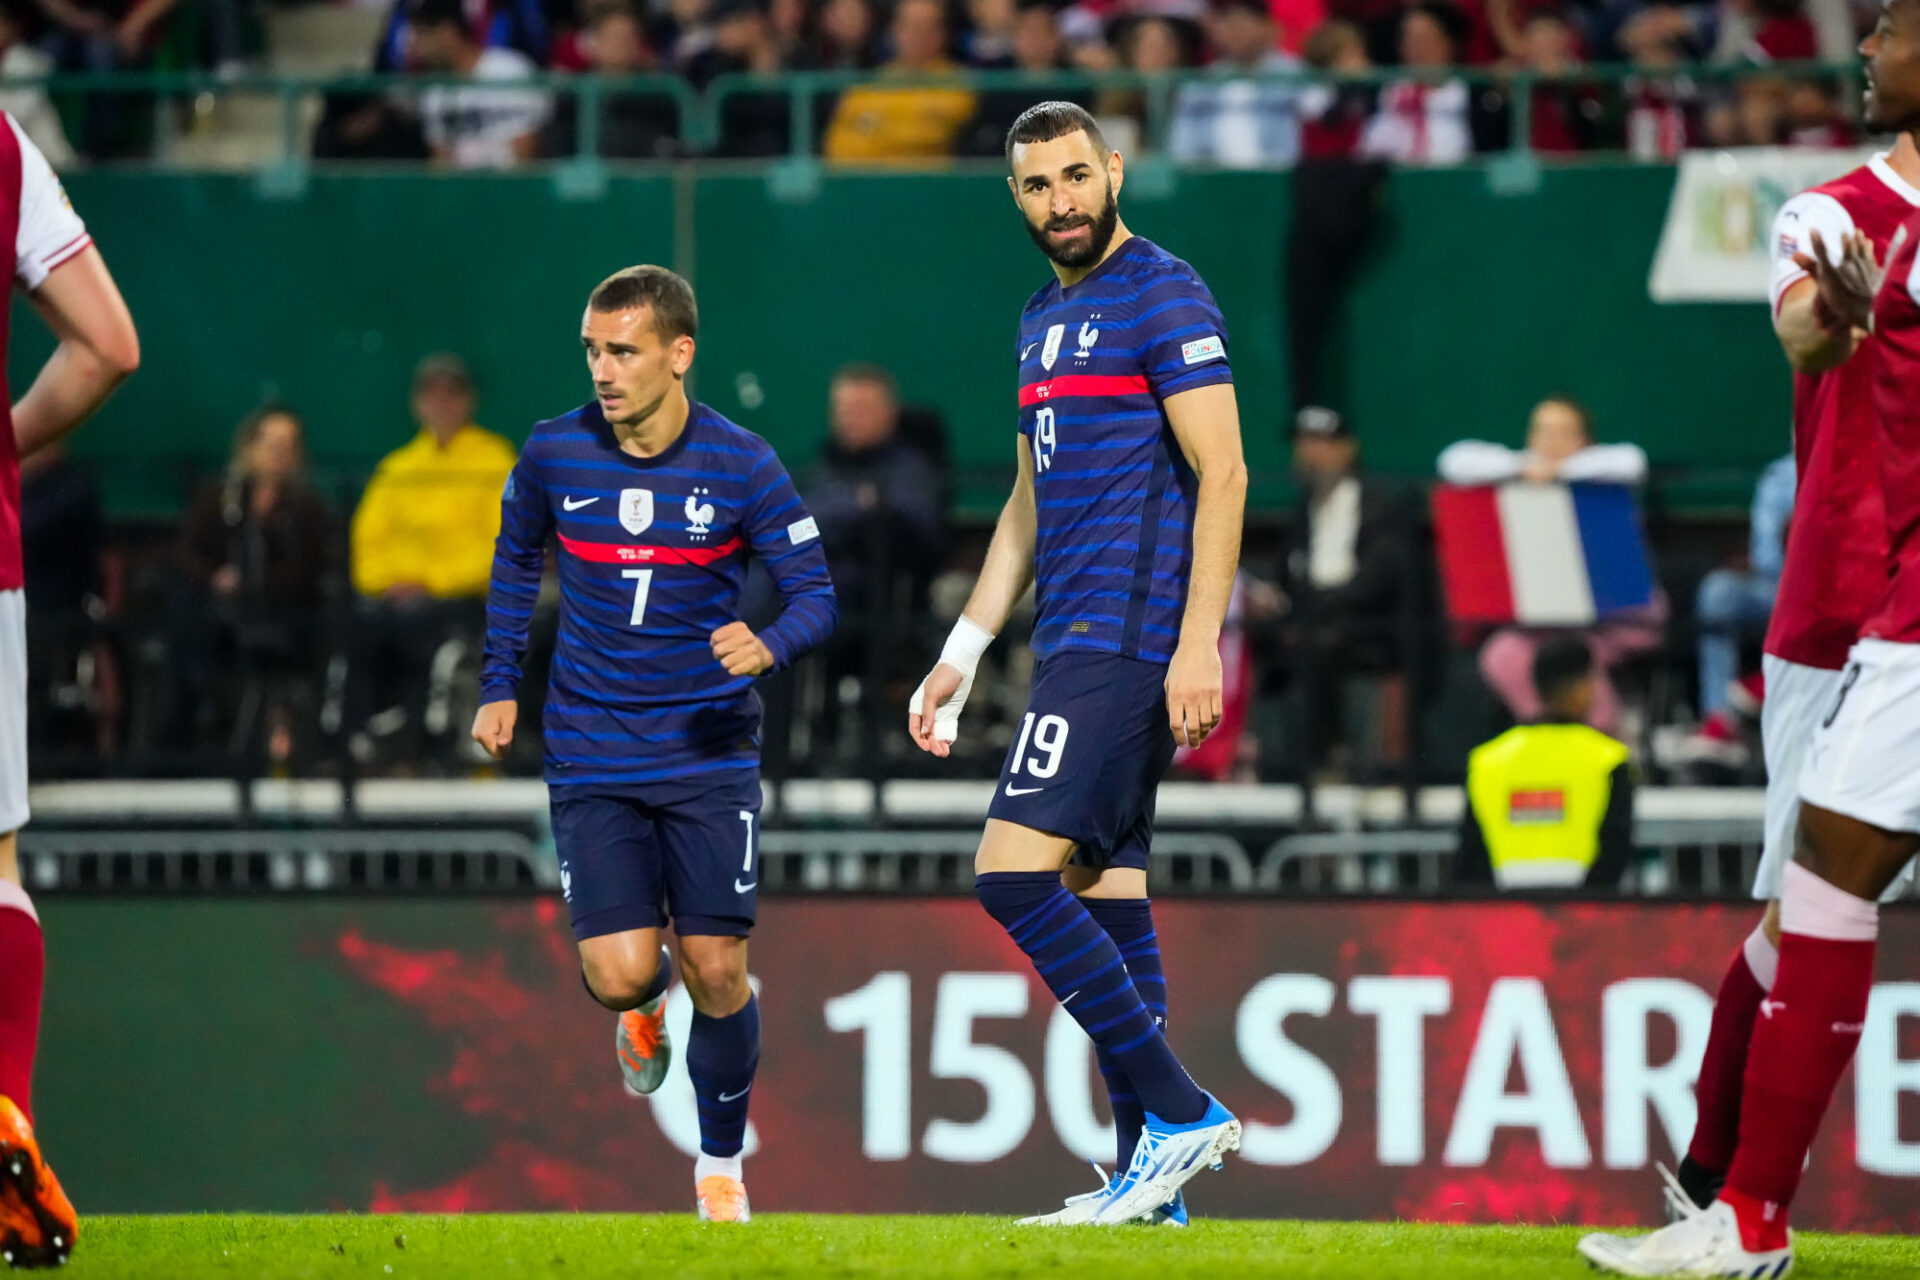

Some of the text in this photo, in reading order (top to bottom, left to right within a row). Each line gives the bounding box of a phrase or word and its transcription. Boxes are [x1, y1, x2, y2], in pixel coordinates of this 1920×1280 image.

[1034, 407, 1056, 472] 19
[621, 569, 653, 626] 7
[1010, 711, 1069, 778] 19
